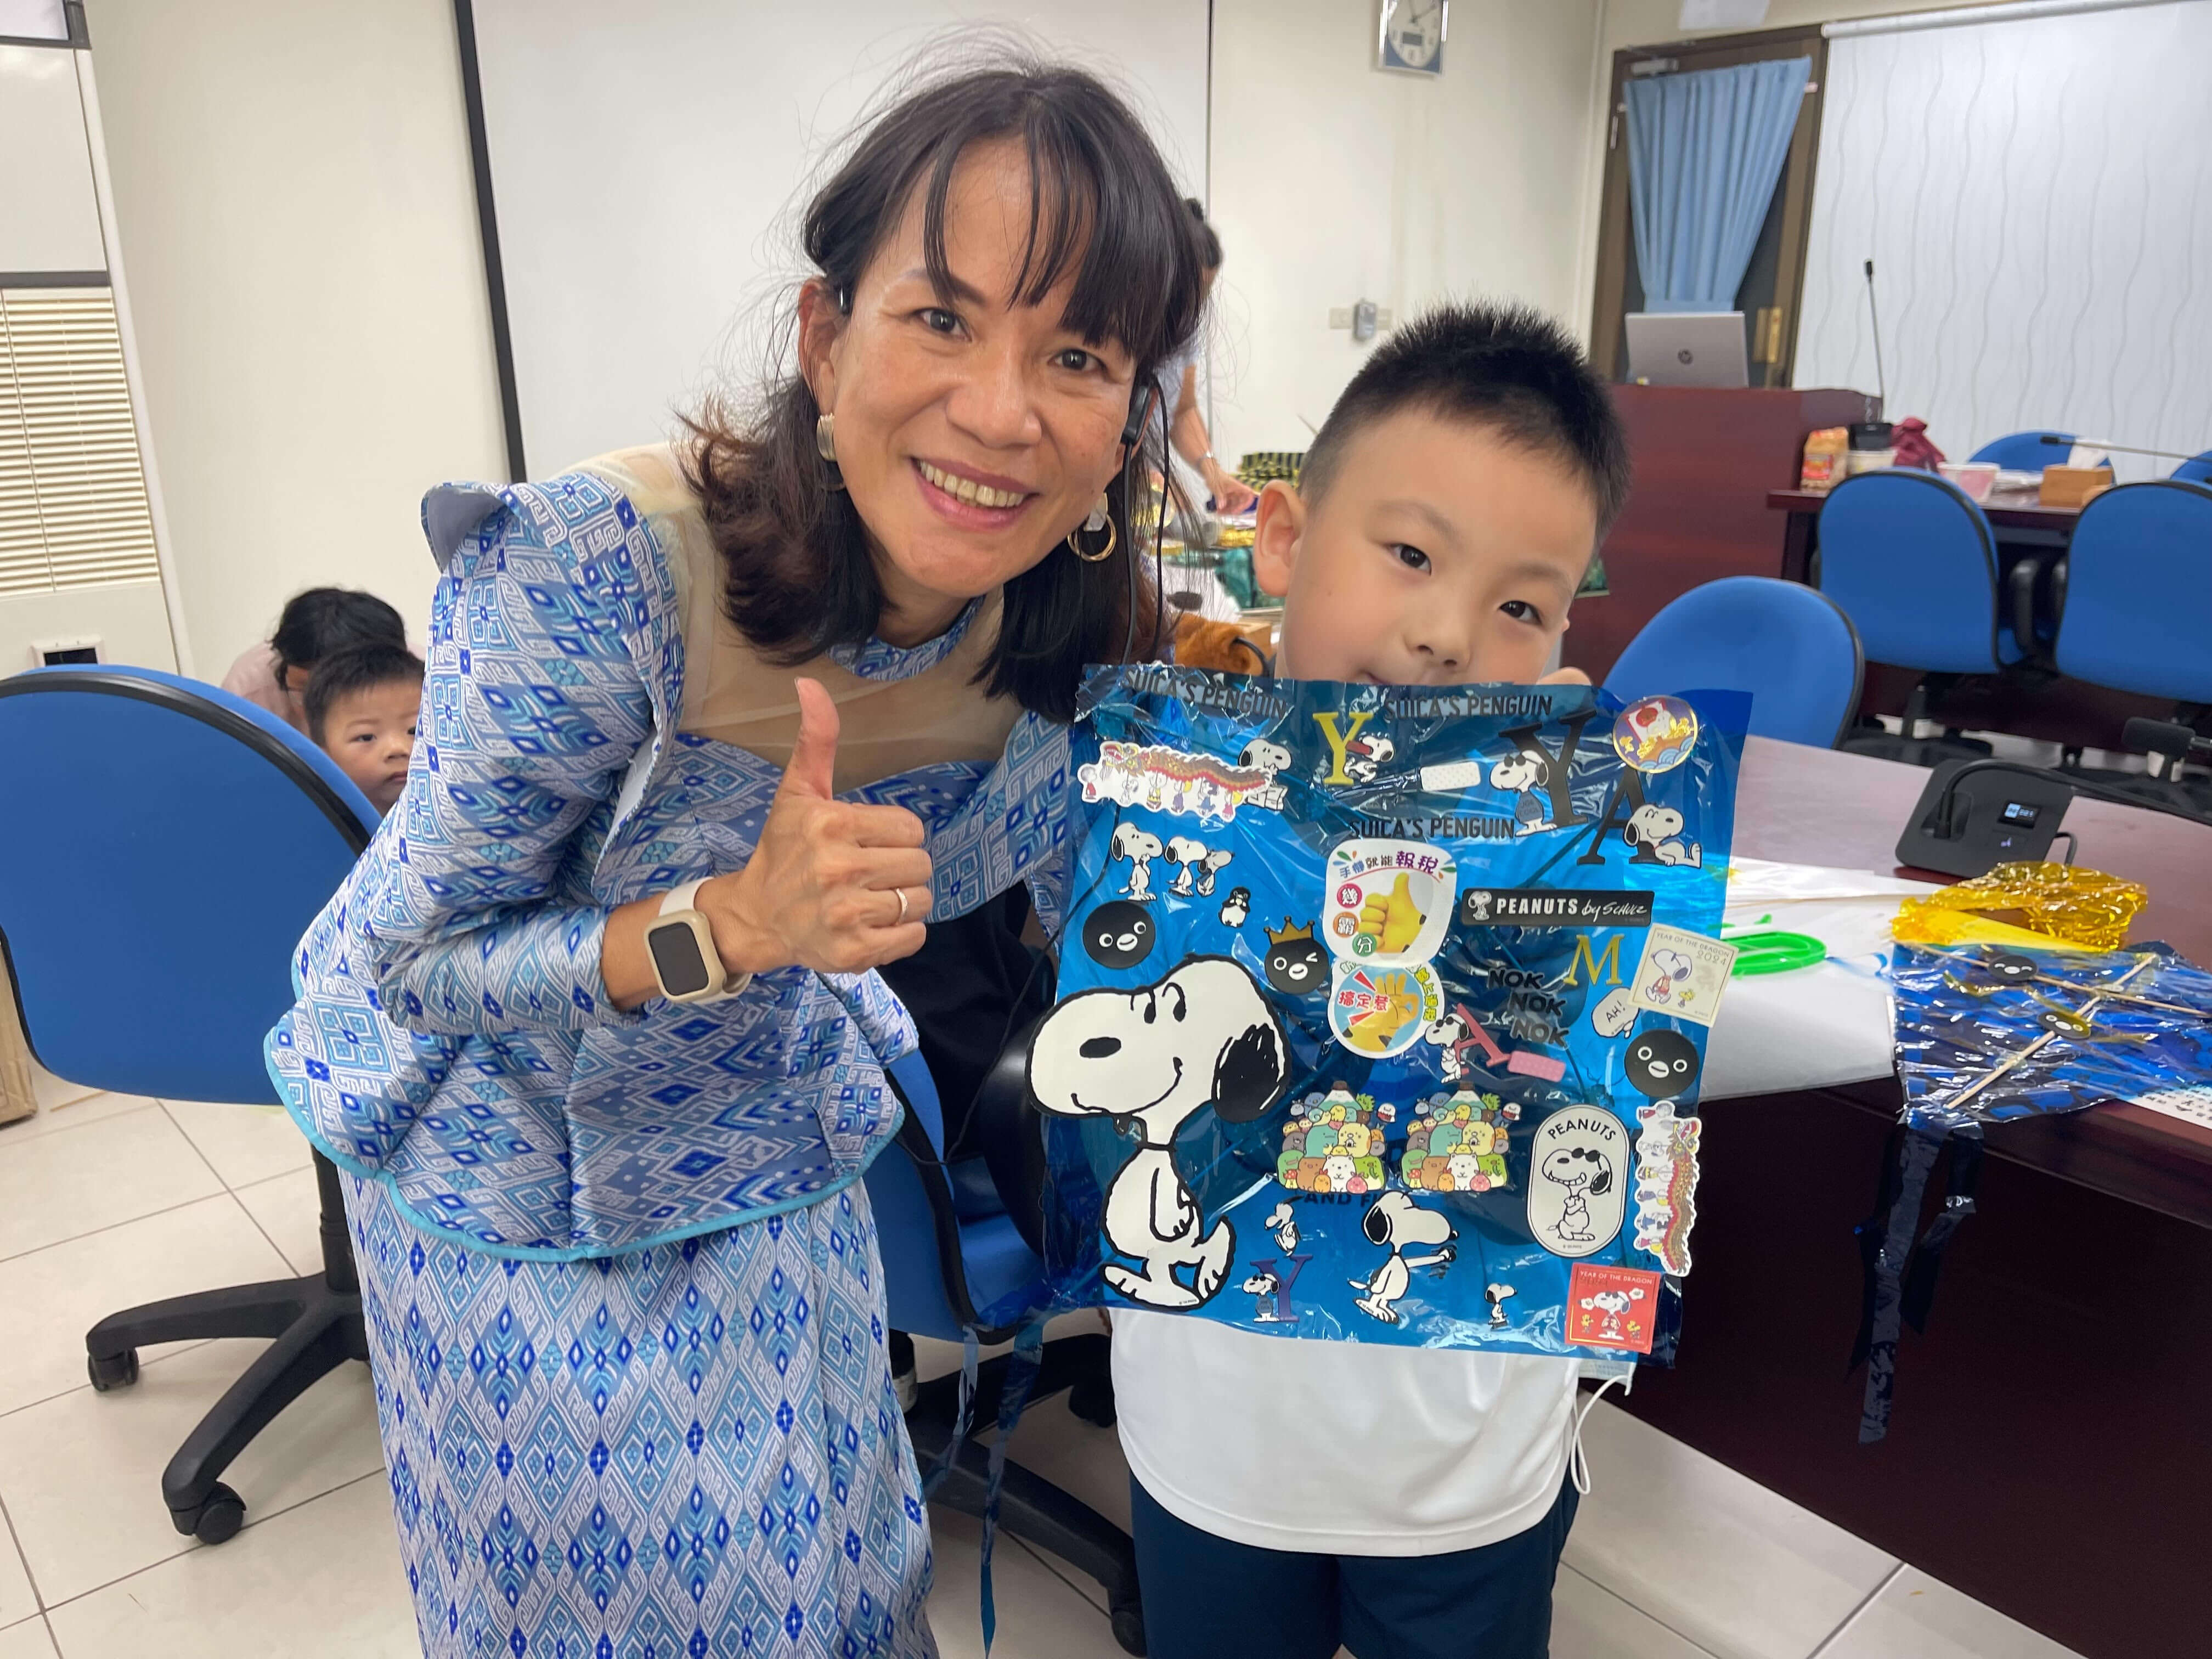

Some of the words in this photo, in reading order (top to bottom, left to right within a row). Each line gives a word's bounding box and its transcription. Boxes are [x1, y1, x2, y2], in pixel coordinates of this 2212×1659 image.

[1125, 668, 1197, 702] SUICA'S
[1202, 682, 1288, 719] PENGUIN
[1384, 696, 1460, 719] SUICA'S
[1467, 695, 1552, 716] PENGUIN
[1313, 712, 1373, 785] Y
[1498, 711, 1597, 827] Y
[1351, 817, 1423, 838] SUICA'S
[1430, 817, 1514, 838] PENGUIN
[1497, 898, 1578, 915] PEANUTS
[1582, 899, 1599, 922] by
[1656, 932, 1673, 941] YEAR
[1685, 939, 1698, 947] THE
[1699, 943, 1729, 957] DRAGON
[1563, 934, 1624, 986] M
[1696, 950, 1726, 966] 2024
[1488, 969, 1544, 989] NOK
[1509, 992, 1566, 1016] NOK
[1606, 999, 1626, 1023] AH!
[1511, 1019, 1570, 1047] NOK
[1547, 1118, 1616, 1141] PEANUTS
[1250, 1254, 1314, 1322] Y
[1623, 1276, 1652, 1285] DRAGON
